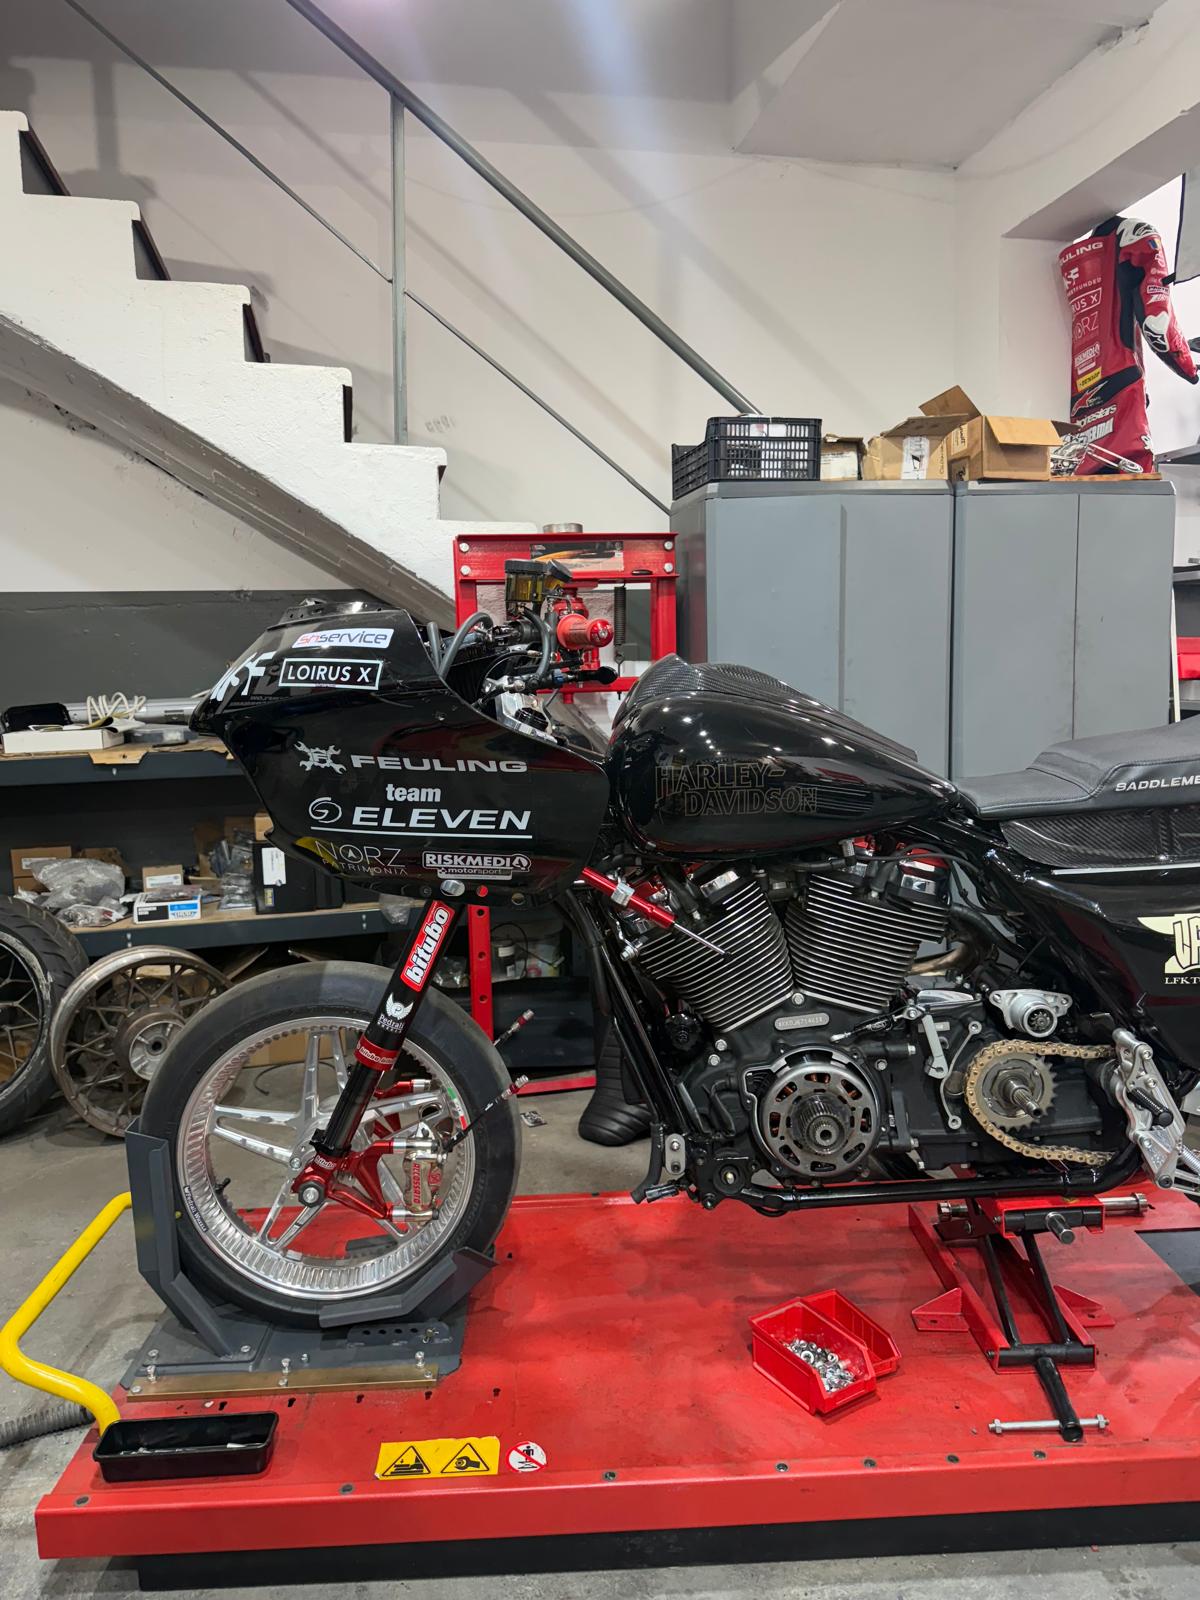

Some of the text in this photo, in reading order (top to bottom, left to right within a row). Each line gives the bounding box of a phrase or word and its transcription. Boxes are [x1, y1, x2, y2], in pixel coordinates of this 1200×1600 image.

[1089, 293, 1098, 304] X
[287, 664, 373, 683] LOIRUS X
[350, 754, 528, 773] FEULING
[385, 783, 442, 803] team
[684, 785, 818, 817] DAVIDSON
[351, 806, 532, 831] ELEVEN
[314, 840, 407, 869] NORZ
[405, 906, 451, 985] bitubo
